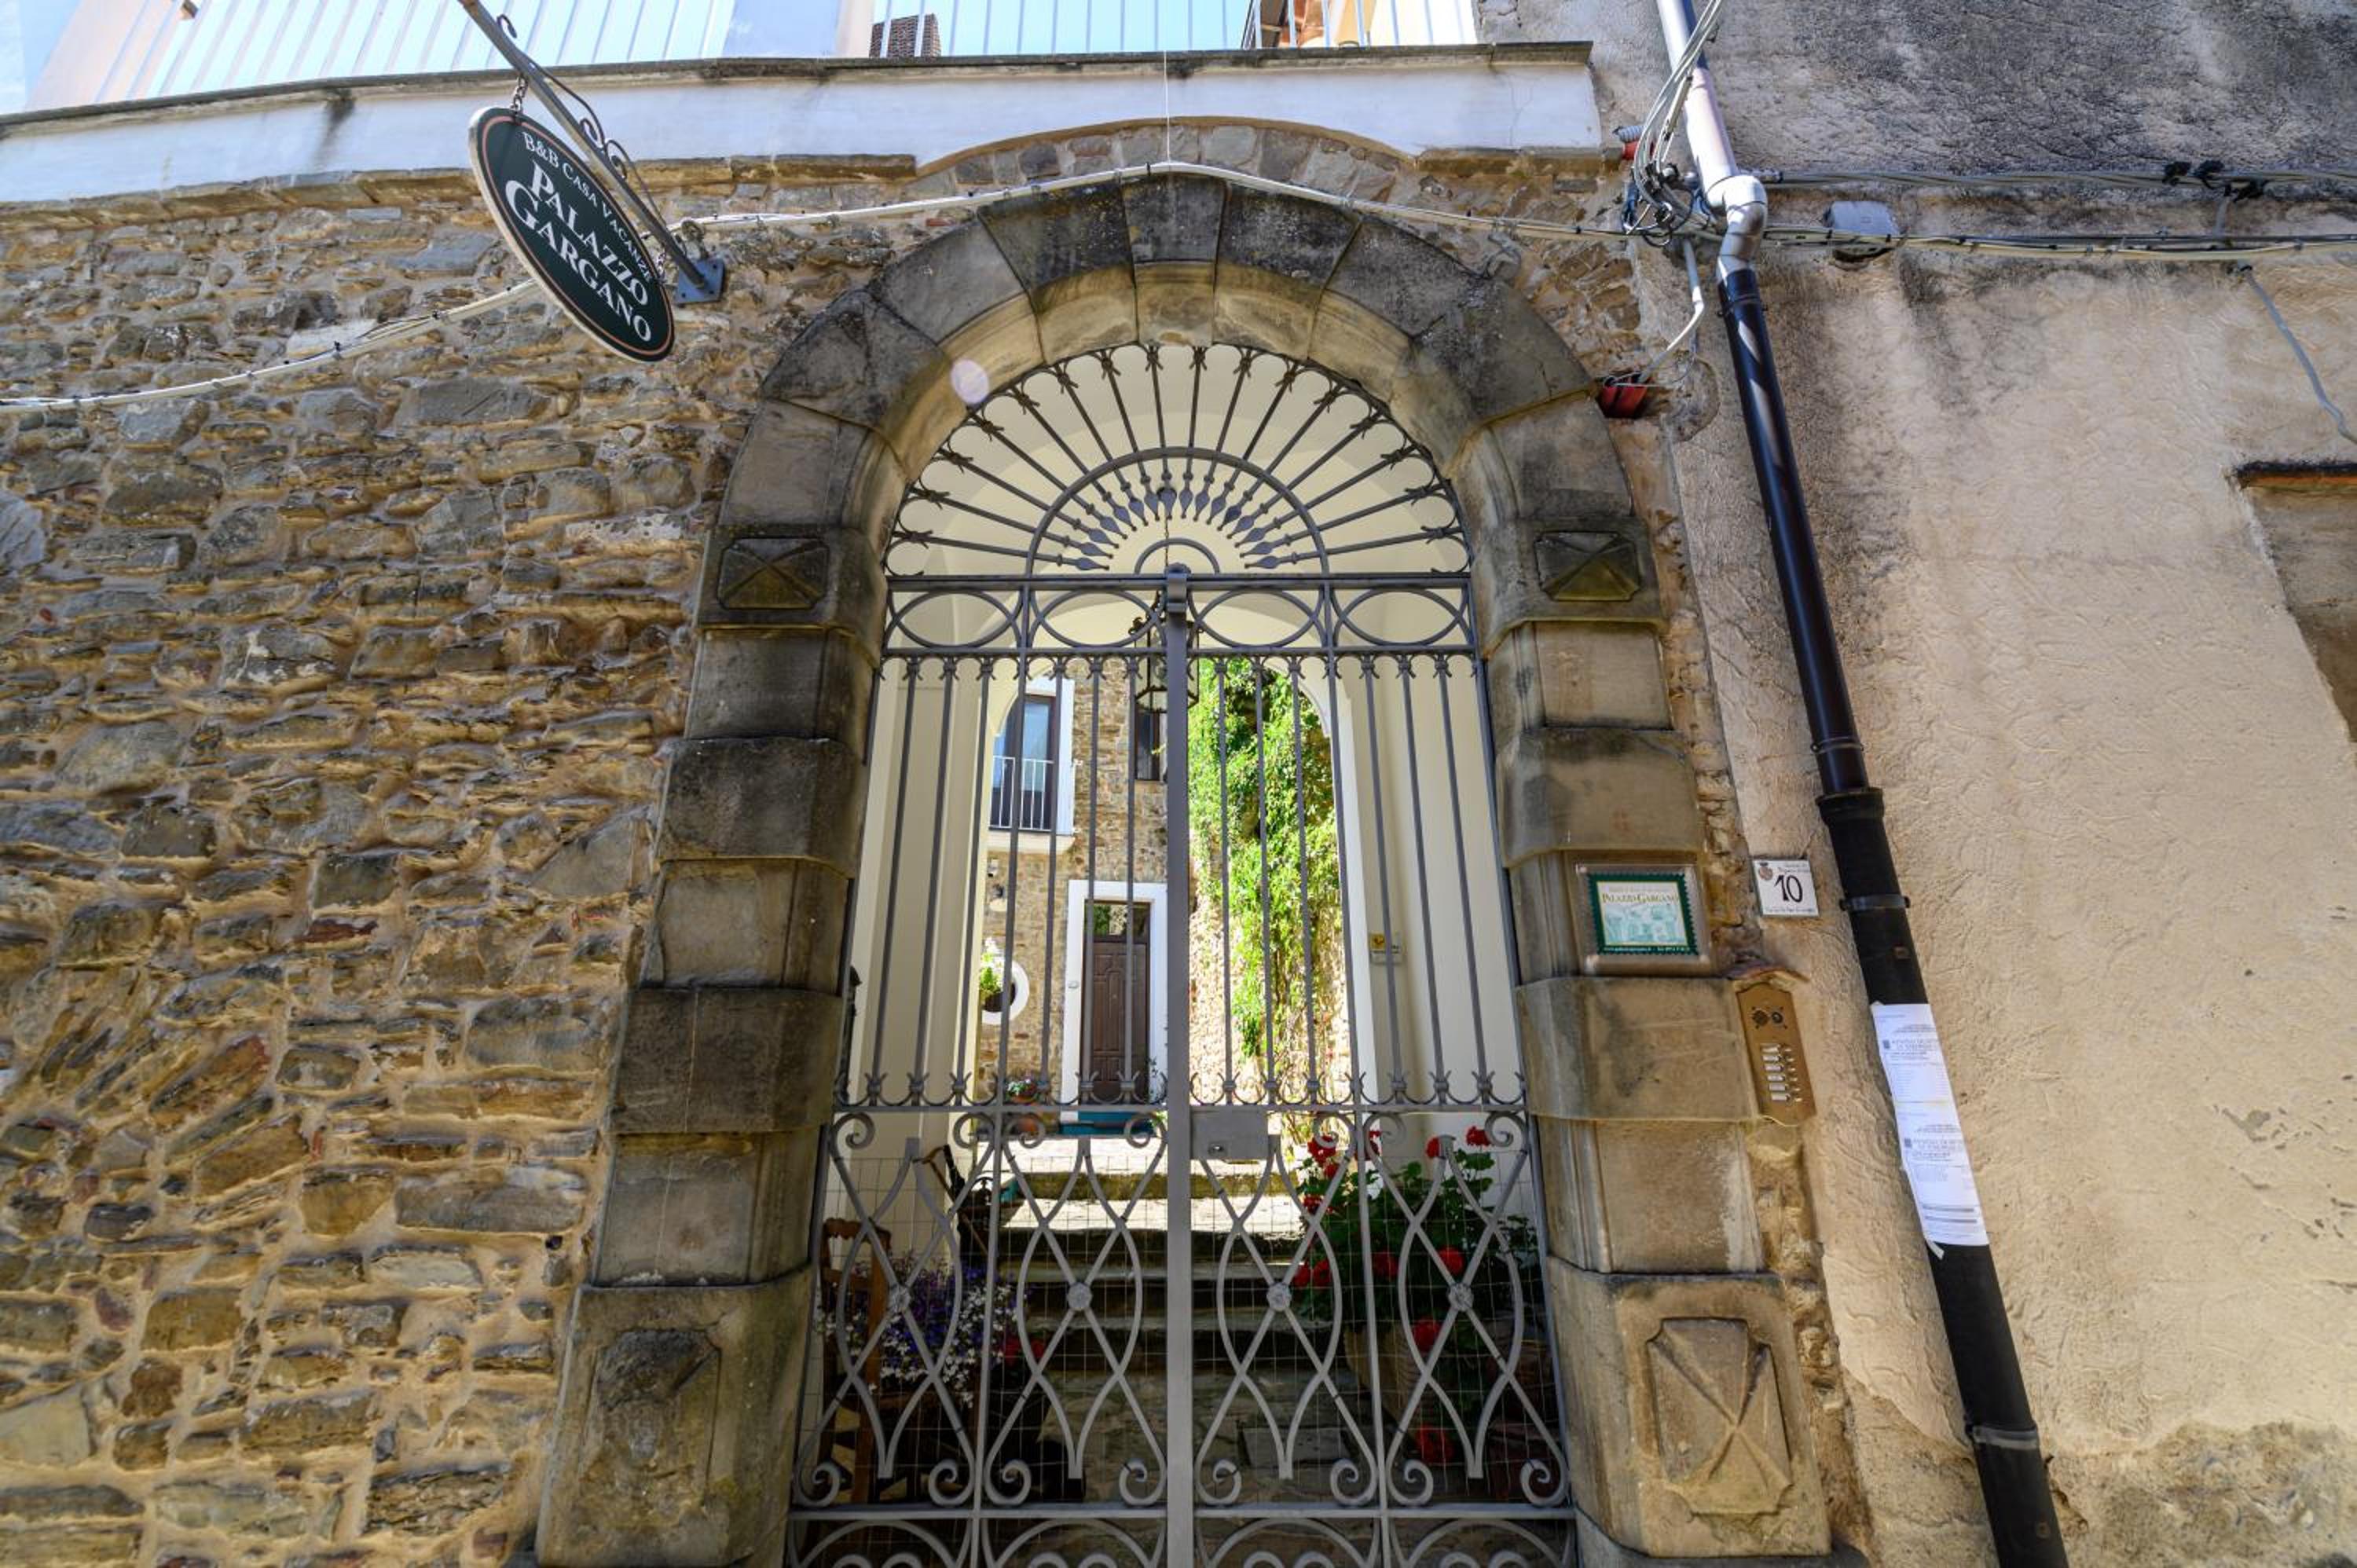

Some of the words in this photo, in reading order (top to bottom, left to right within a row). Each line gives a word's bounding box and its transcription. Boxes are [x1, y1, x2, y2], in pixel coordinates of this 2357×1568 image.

[505, 179, 651, 342] GARGANO
[522, 131, 559, 168] B&B
[562, 163, 598, 208] CASA
[601, 200, 651, 283] VACANZE
[529, 159, 648, 306] PALAZZO
[1773, 874, 1803, 903] 10
